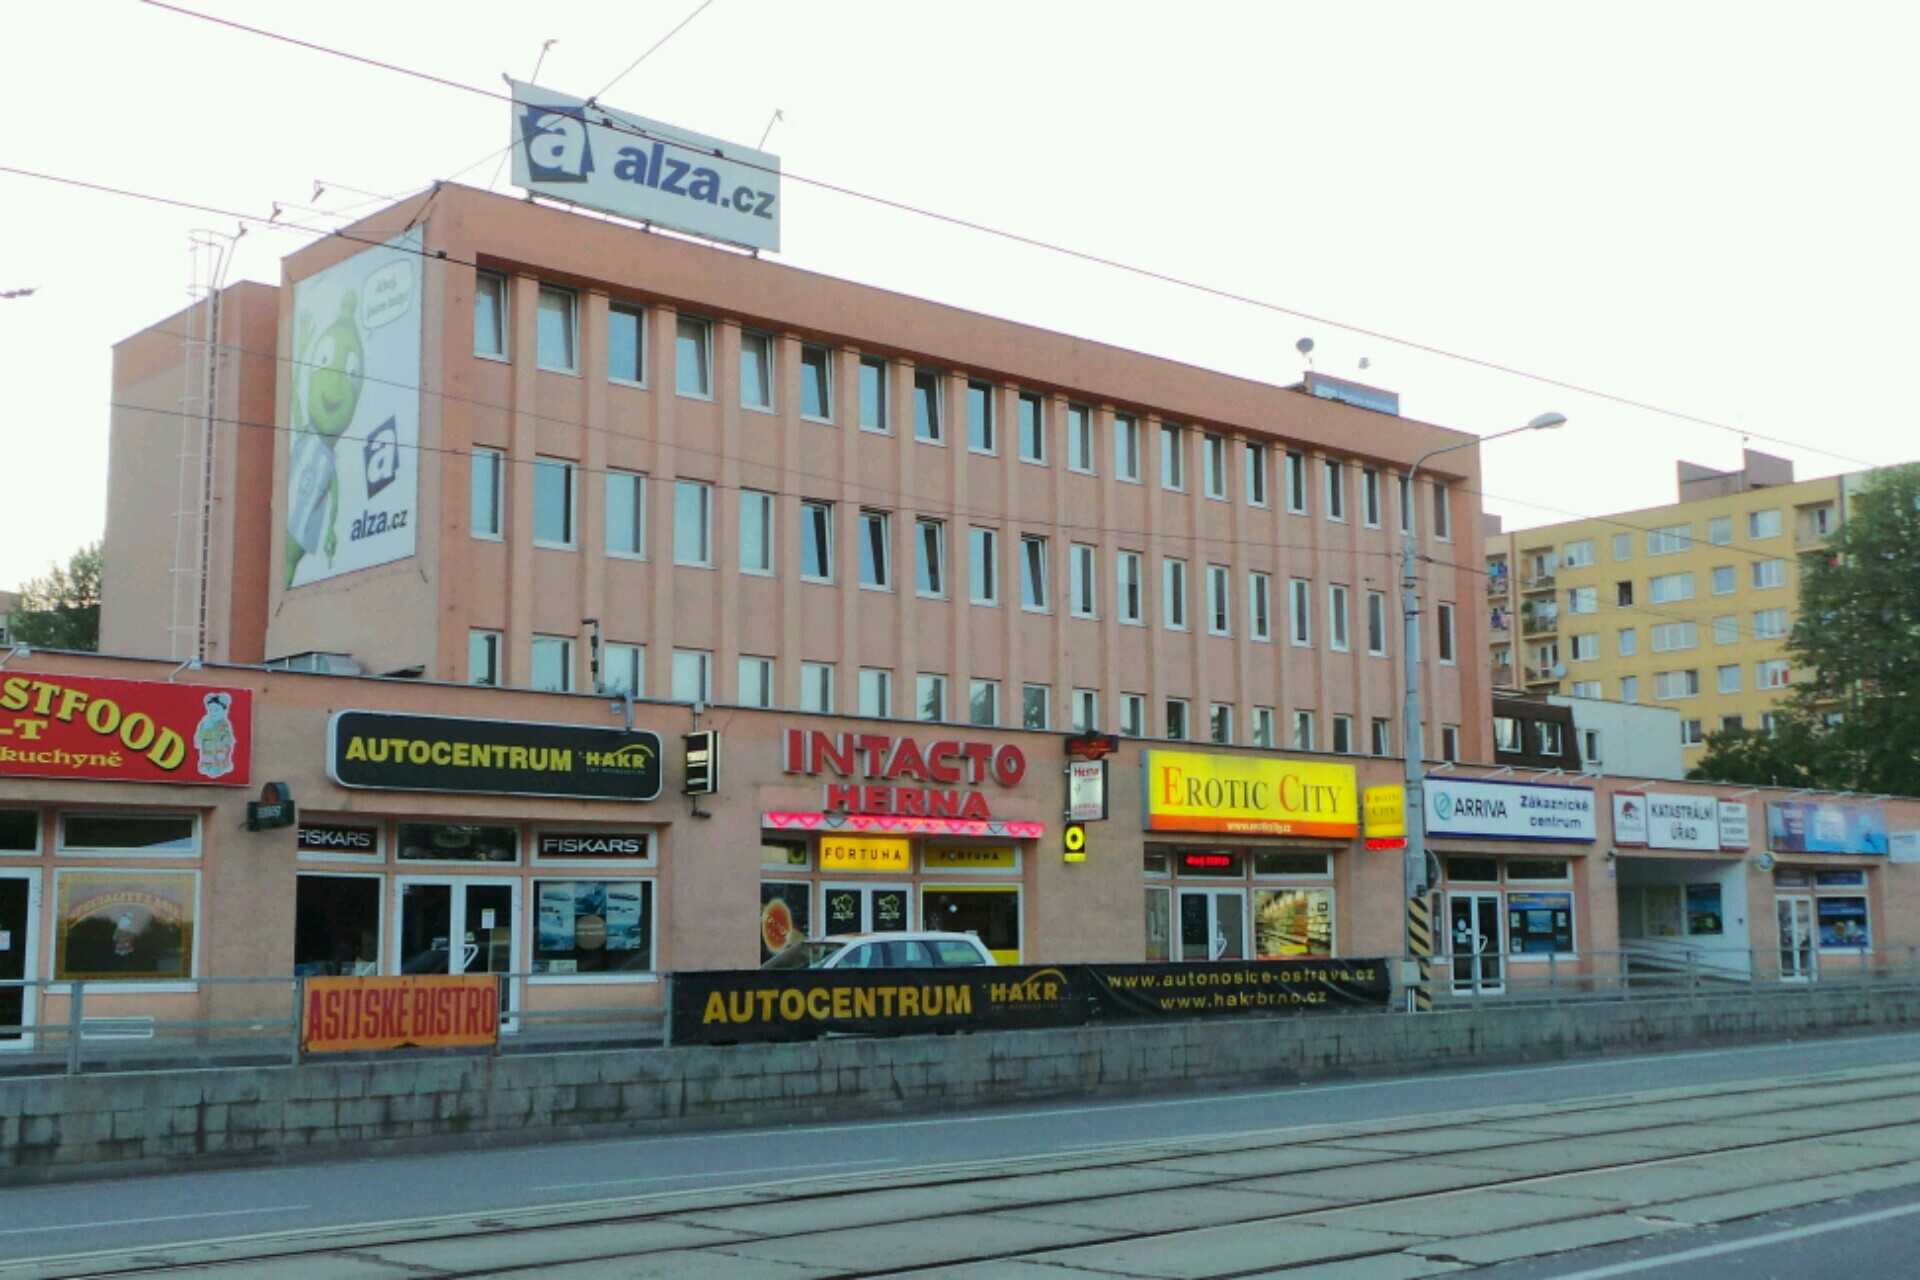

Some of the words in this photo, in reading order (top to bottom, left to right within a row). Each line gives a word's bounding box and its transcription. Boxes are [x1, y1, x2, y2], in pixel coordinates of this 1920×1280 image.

[613, 142, 776, 220] alza.cz
[351, 509, 408, 541] alza.cz
[0, 746, 123, 768] kuchyně
[345, 736, 572, 771] AUTOCENTRUM
[586, 751, 645, 768] HAKR
[784, 729, 1026, 787] INTACTO
[824, 783, 991, 819] HERNA
[1454, 797, 1508, 818] ARRIVA
[1520, 795, 1589, 812] Zákaznické
[1651, 801, 1714, 821] KATASTRÁLNÍ
[1530, 816, 1582, 829] centrum
[1671, 821, 1697, 840] ÚŘAD
[543, 838, 639, 853] FISKARS
[825, 846, 902, 861] FORTUNA
[940, 851, 999, 861] FORTUNA
[1108, 969, 1375, 988] www.autonosice-ostrava.cz
[703, 985, 972, 1024] AUTOCENTRUM
[991, 982, 1058, 1002] HAKR
[1161, 991, 1327, 1009] www.hakrbrno.cz
[308, 980, 410, 1041] ASIJSKÉ
[413, 986, 496, 1038] BISTRO
